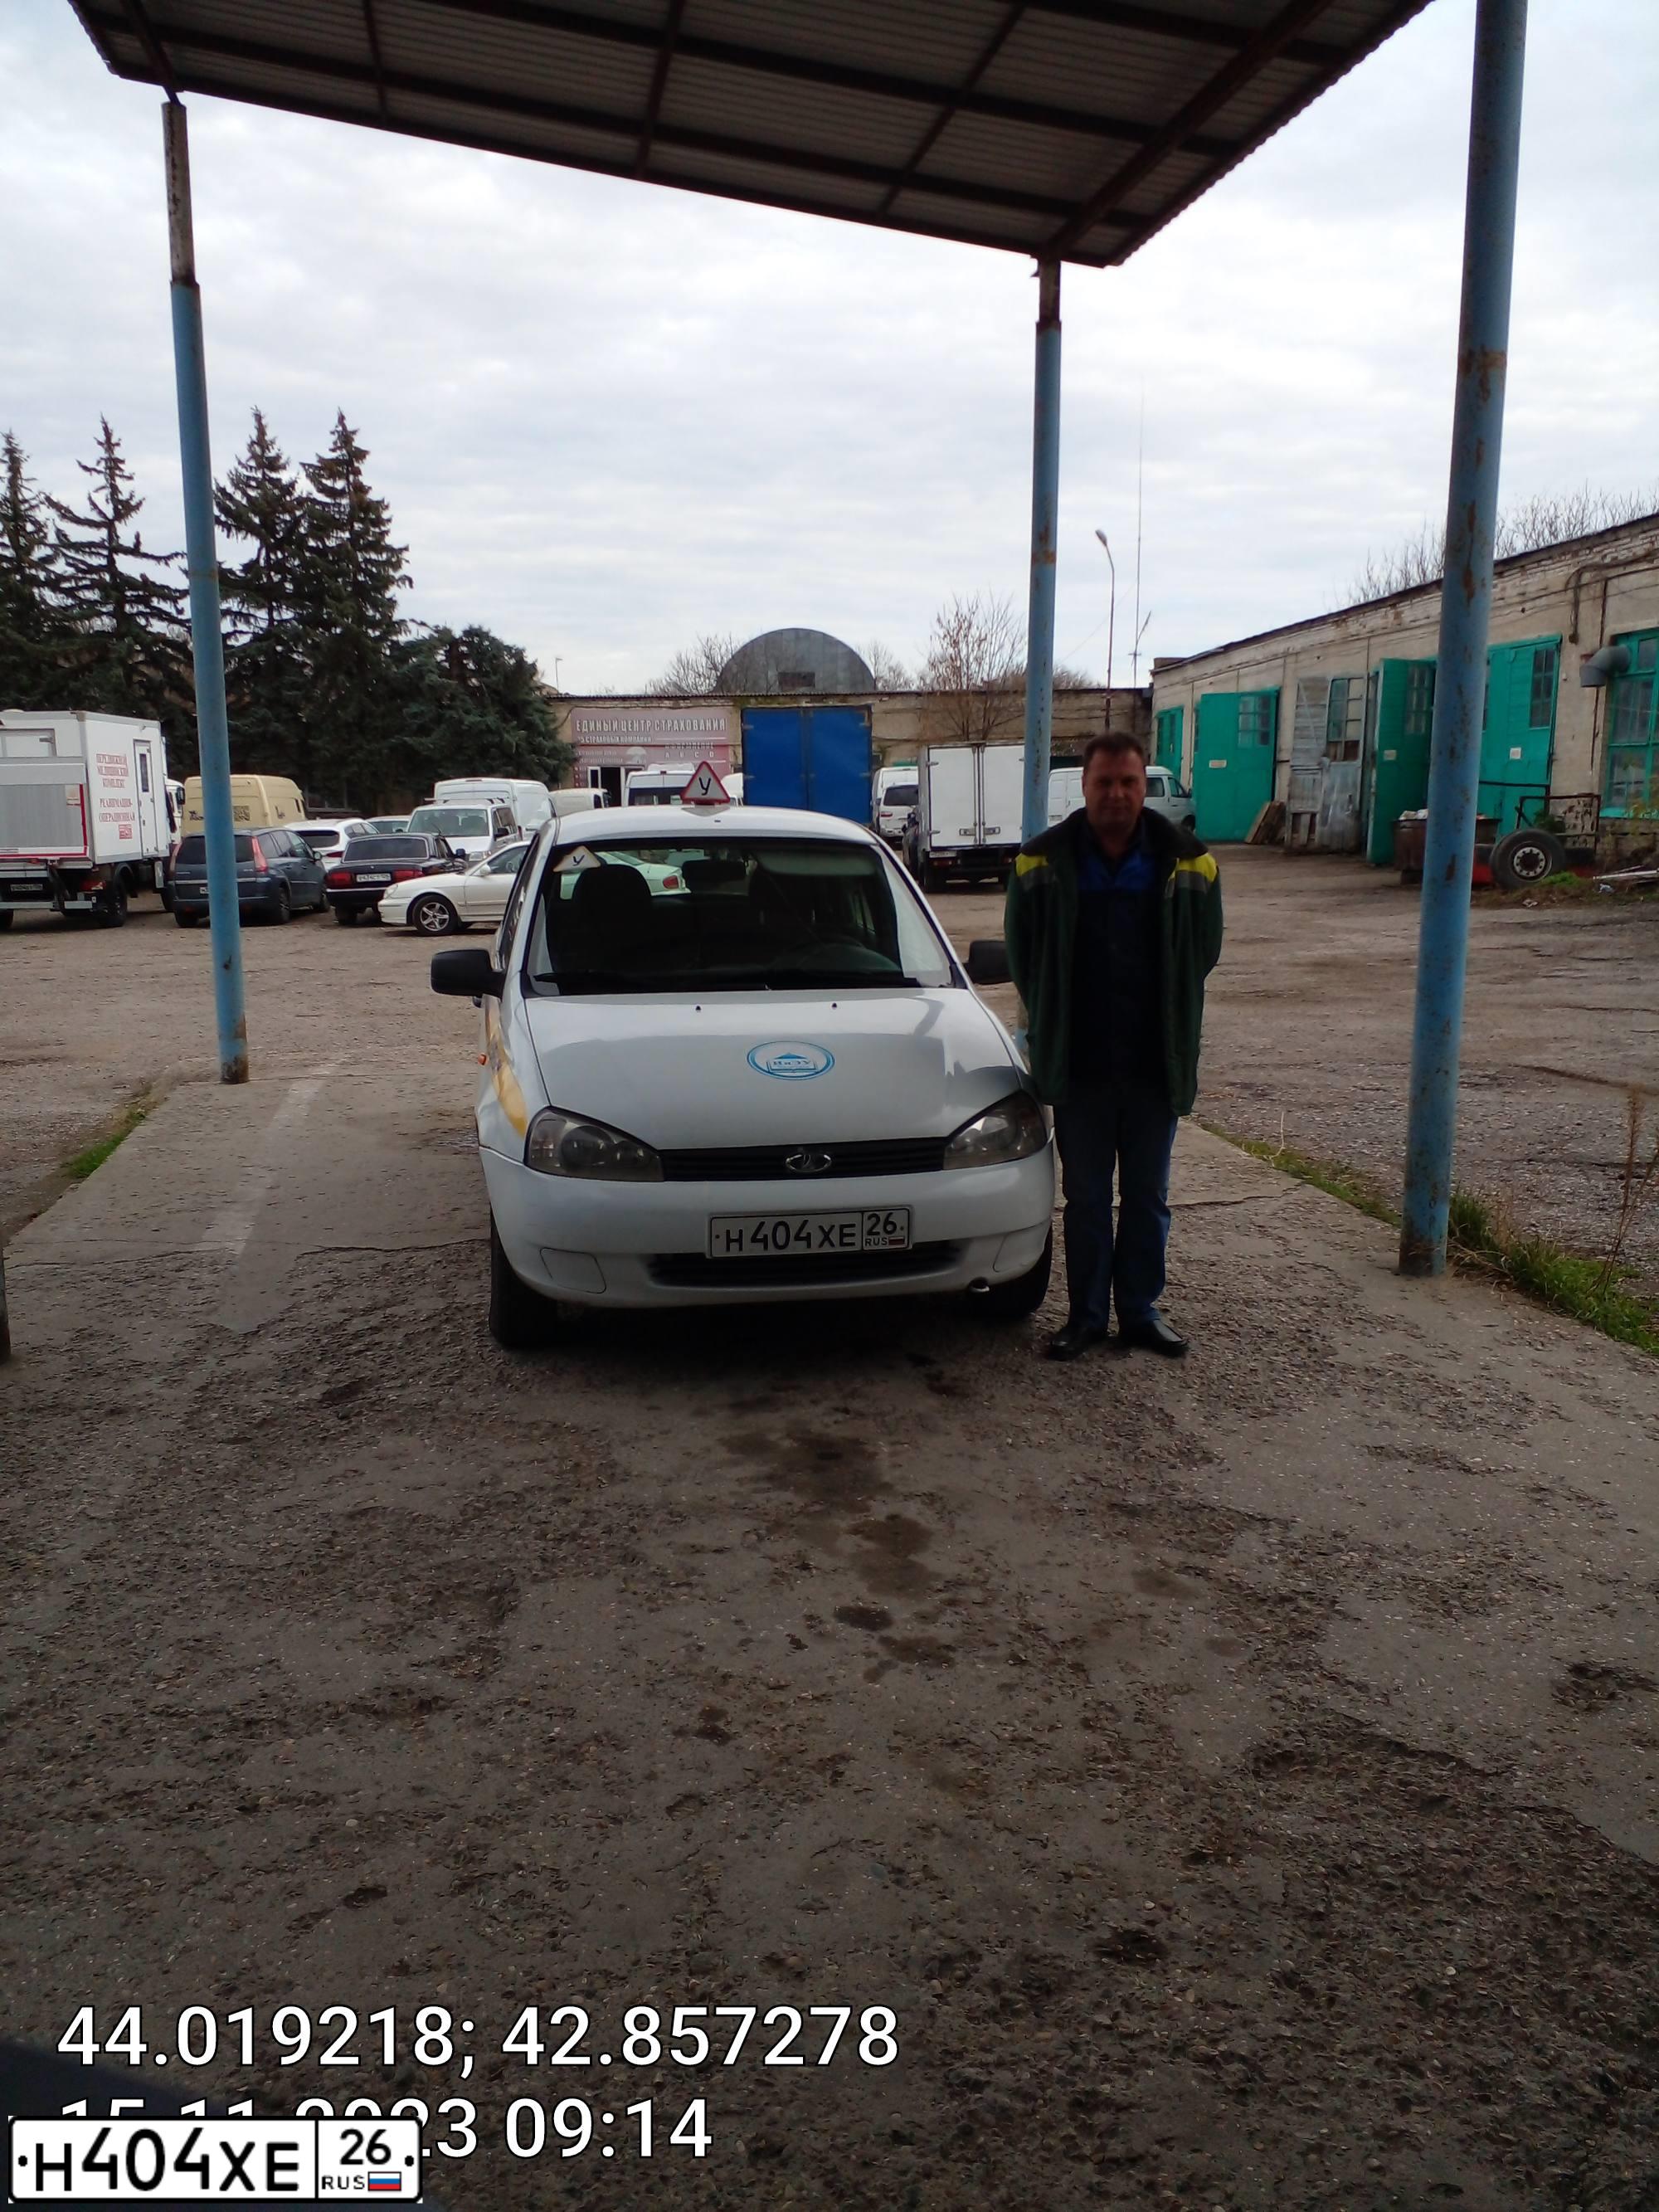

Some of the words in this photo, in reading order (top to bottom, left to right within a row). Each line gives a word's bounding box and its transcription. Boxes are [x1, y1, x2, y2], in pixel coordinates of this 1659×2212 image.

[576, 719, 619, 733] ЕДИНЫЙ
[620, 719, 652, 733] ЦЕНТР
[654, 718, 726, 732] СТРАХОВАНИЯ
[698, 777, 712, 796] У
[572, 855, 585, 865] У
[866, 1212, 898, 1237] 26
[864, 1237, 888, 1247] RUS
